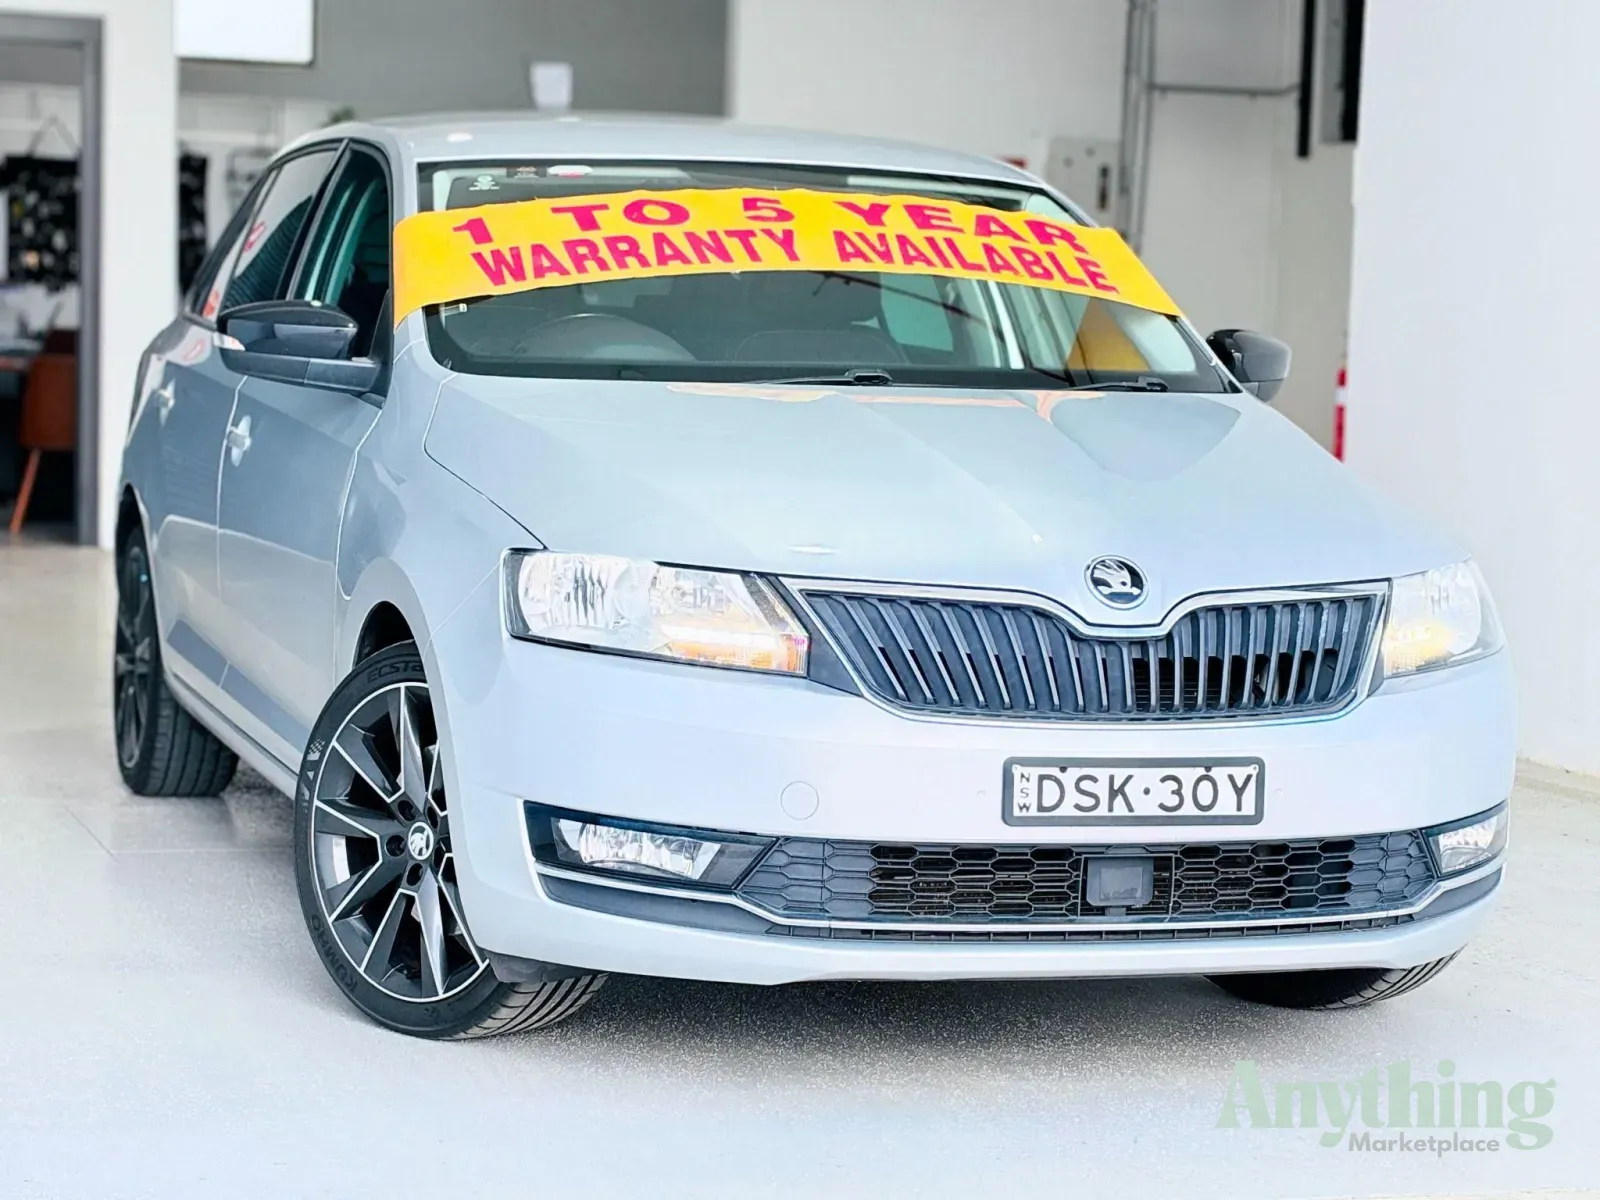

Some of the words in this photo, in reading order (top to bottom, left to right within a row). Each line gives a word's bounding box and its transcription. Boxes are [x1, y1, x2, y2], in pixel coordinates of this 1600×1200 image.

[453, 217, 493, 245] 1
[550, 199, 690, 232] TO
[742, 197, 795, 223] 5
[833, 201, 1090, 255] YEAR
[470, 228, 801, 287] WARRANTY
[832, 230, 1119, 294] AVAILABLE
